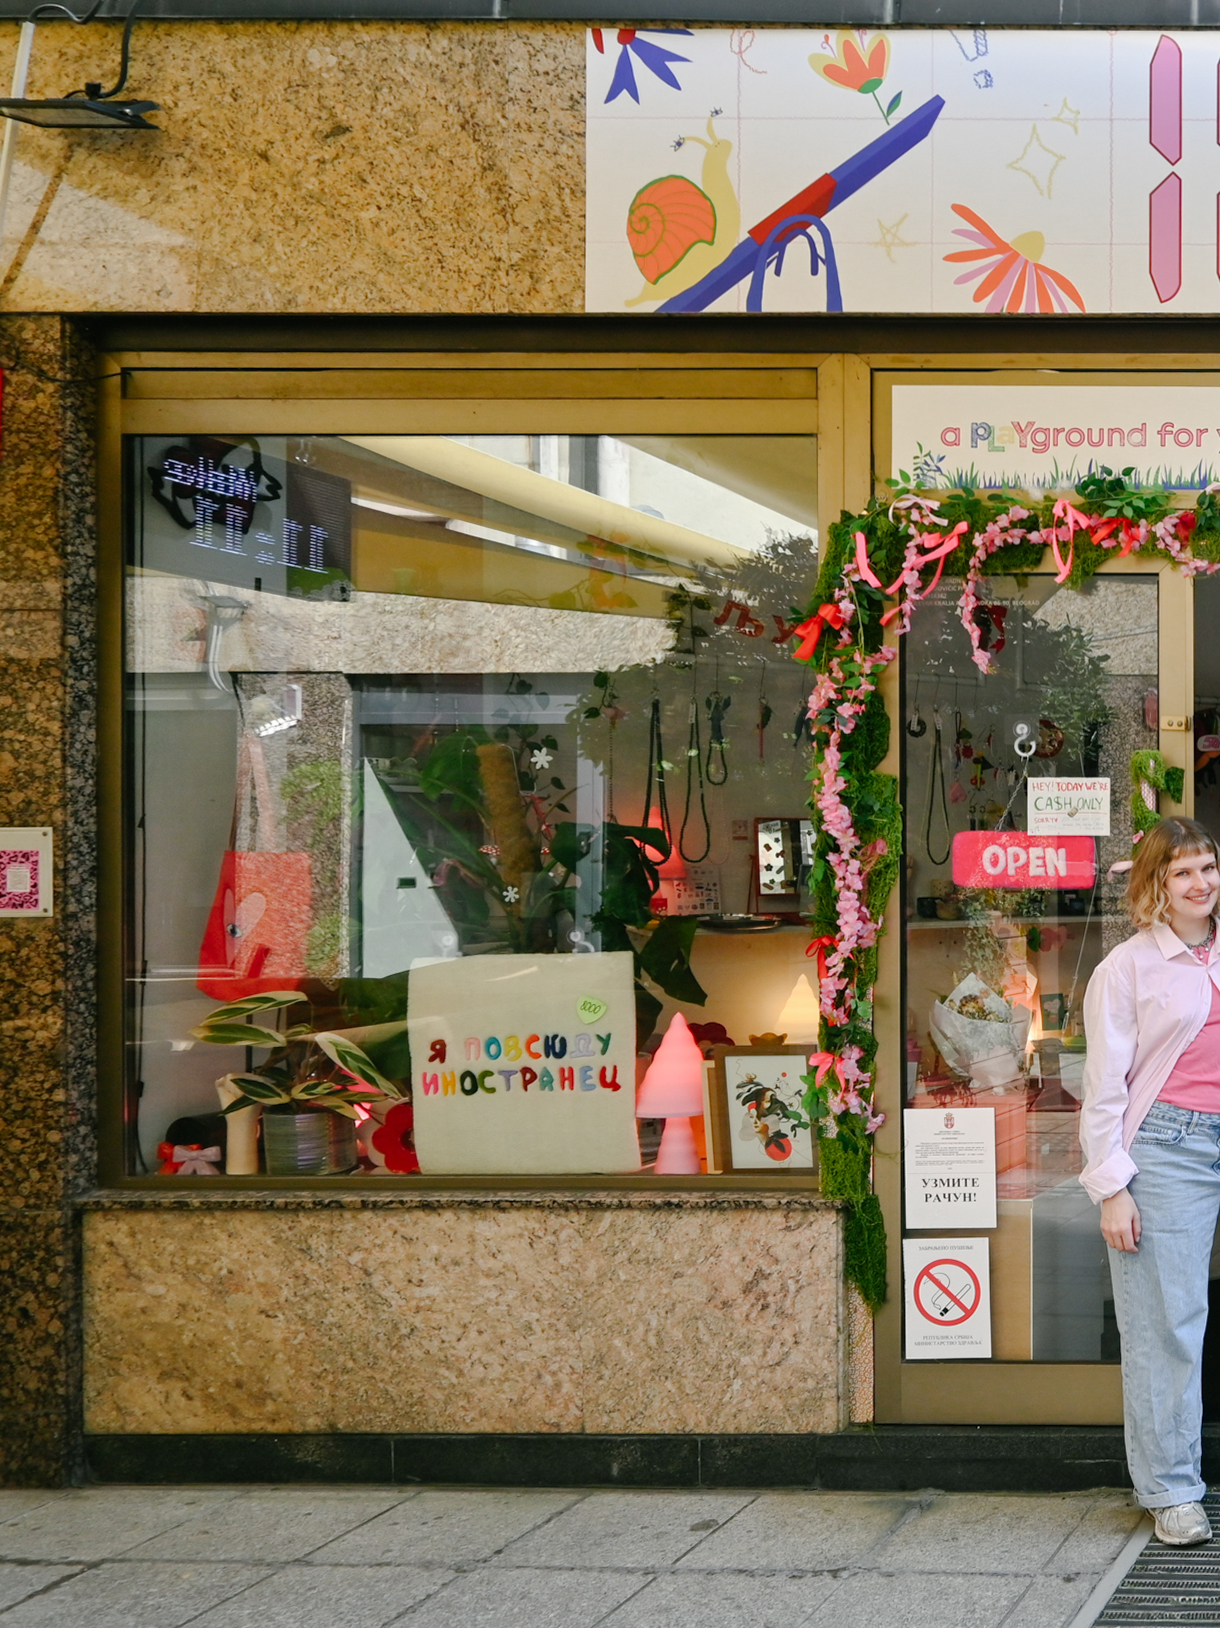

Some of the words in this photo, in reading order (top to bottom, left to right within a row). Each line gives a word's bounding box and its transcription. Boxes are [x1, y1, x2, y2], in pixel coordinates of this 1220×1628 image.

[940, 426, 961, 447] a
[1157, 421, 1208, 447] for
[1031, 781, 1055, 792] HEY!
[1056, 781, 1084, 792] TODAY
[1084, 781, 1109, 792] WE'RE
[1033, 796, 1073, 812] CA$H
[1077, 797, 1104, 811] ONLY
[981, 844, 1068, 877] OPEN
[428, 1038, 447, 1064] Я
[464, 1032, 612, 1063] ПОВСЮДУ
[421, 1064, 622, 1097] ИНОСТРАНЕЦ
[921, 1177, 980, 1188] УЗМИТЕ
[924, 1193, 977, 1202] РАЧУН!
